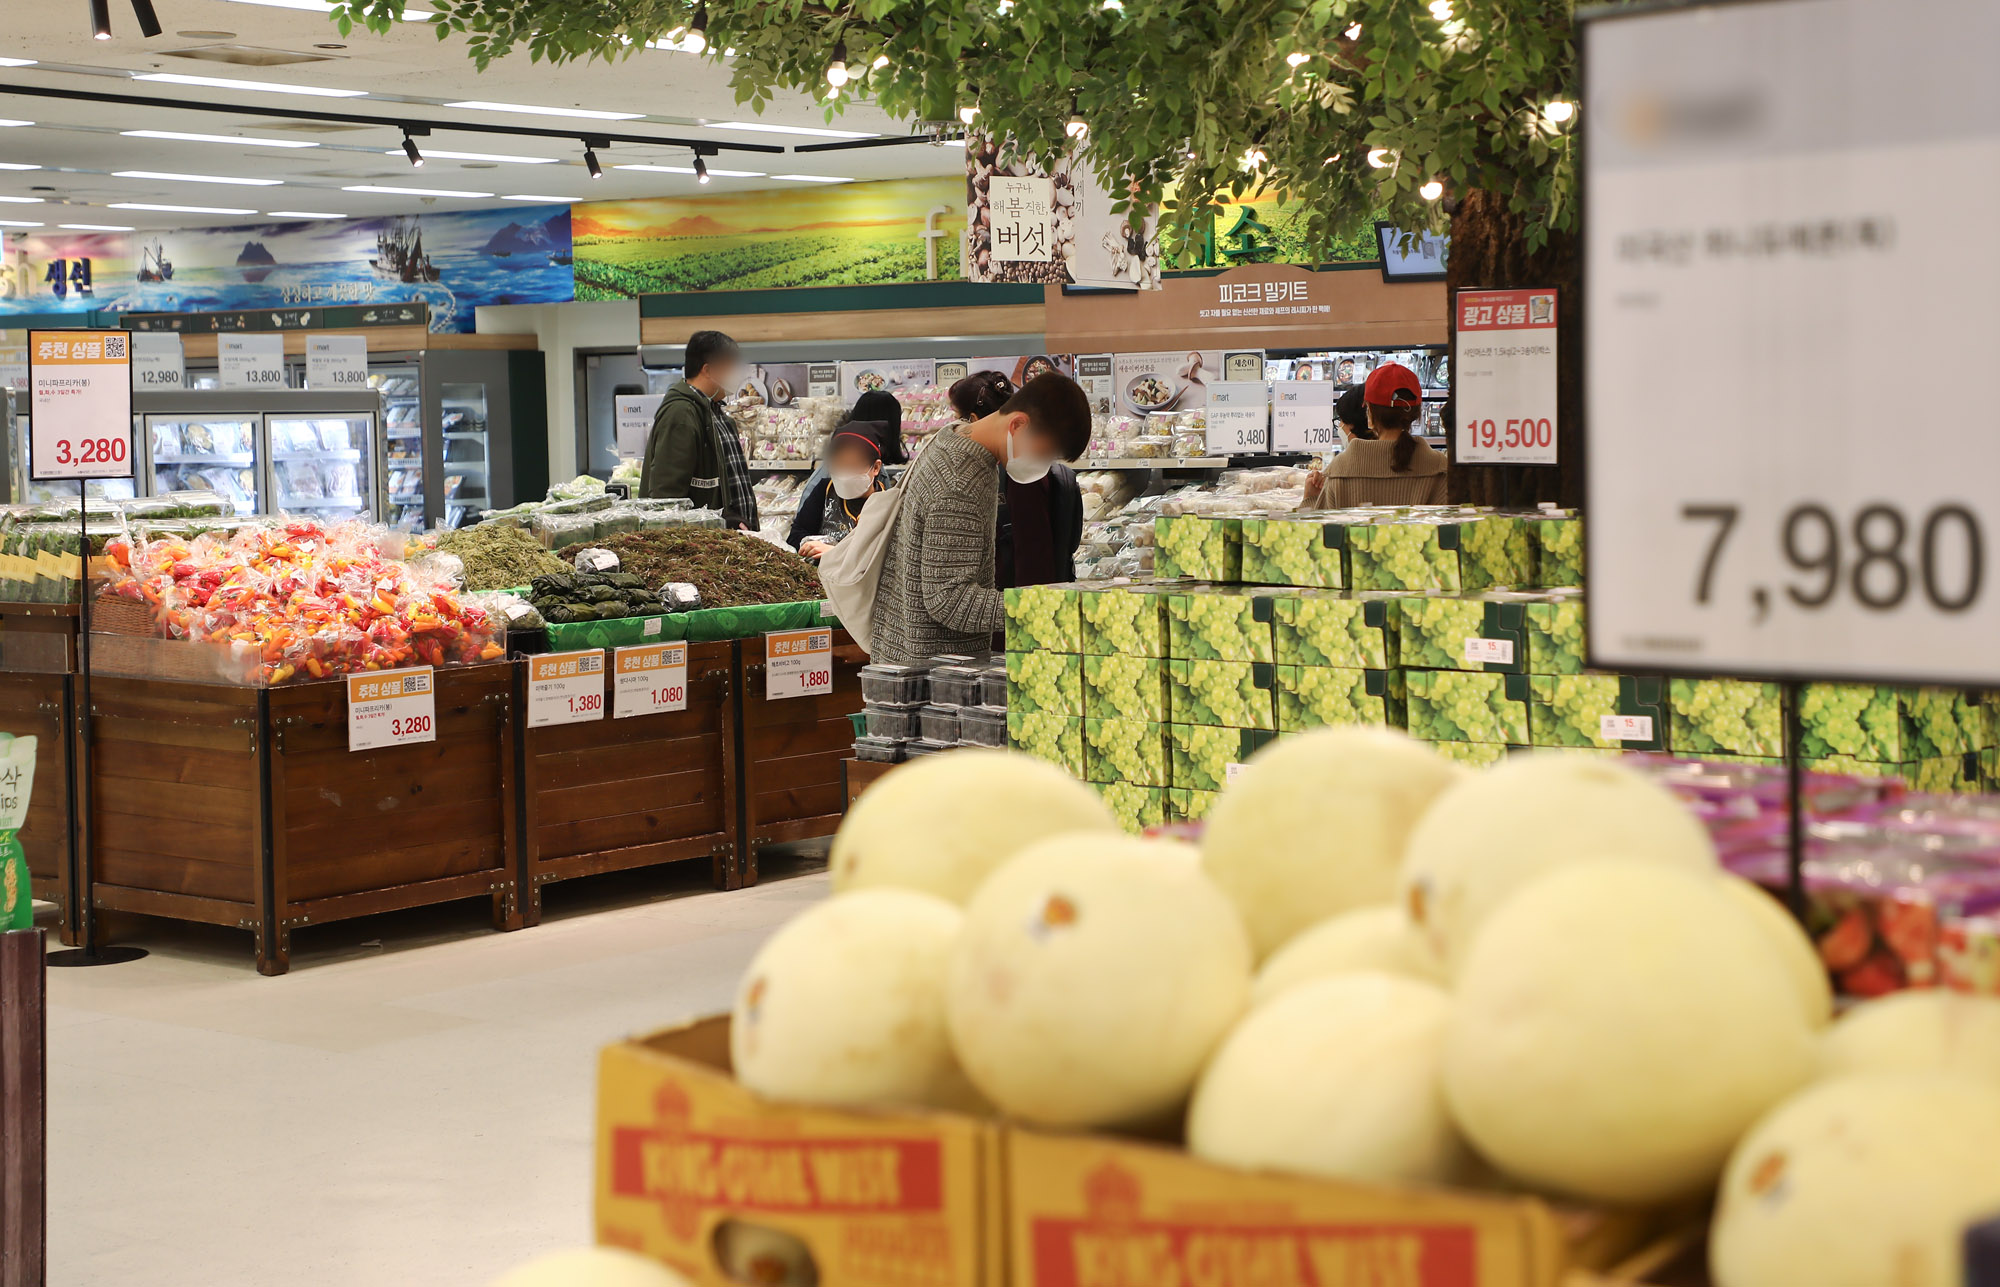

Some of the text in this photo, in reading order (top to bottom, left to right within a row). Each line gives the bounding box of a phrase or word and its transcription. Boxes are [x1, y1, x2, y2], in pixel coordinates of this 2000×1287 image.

[1005, 182, 1034, 194] 누구나,
[996, 221, 1046, 256] 버섯
[45, 257, 92, 298] 생선
[1219, 281, 1308, 303] 피코크 밀키트
[1243, 307, 1259, 316] 신선한
[1464, 304, 1527, 326] 광고 상품
[39, 342, 101, 360] 추천 상품
[1234, 359, 1255, 367] 새송이
[38, 379, 91, 388] 미니파프리카(봉)
[141, 370, 179, 384] 12,980
[245, 370, 281, 383] 13,800
[332, 371, 366, 383] 13,800
[1236, 429, 1266, 447] 3,480
[1304, 428, 1331, 446] 1,780
[1467, 418, 1552, 452] 19,500
[56, 437, 126, 467] 3,280
[1680, 502, 1986, 624] 7,980
[775, 638, 807, 655] 추천 상품
[539, 661, 577, 677] 추천 상품
[623, 654, 660, 670] 추천 상품
[553, 682, 566, 690] 100g
[800, 670, 829, 689] 1,880
[358, 683, 379, 698] 추천
[380, 681, 401, 696] 상품
[650, 686, 683, 706] 1,080
[567, 693, 602, 714] 1,380
[391, 715, 431, 737] 3,280
[0, 766, 22, 792] 삭
